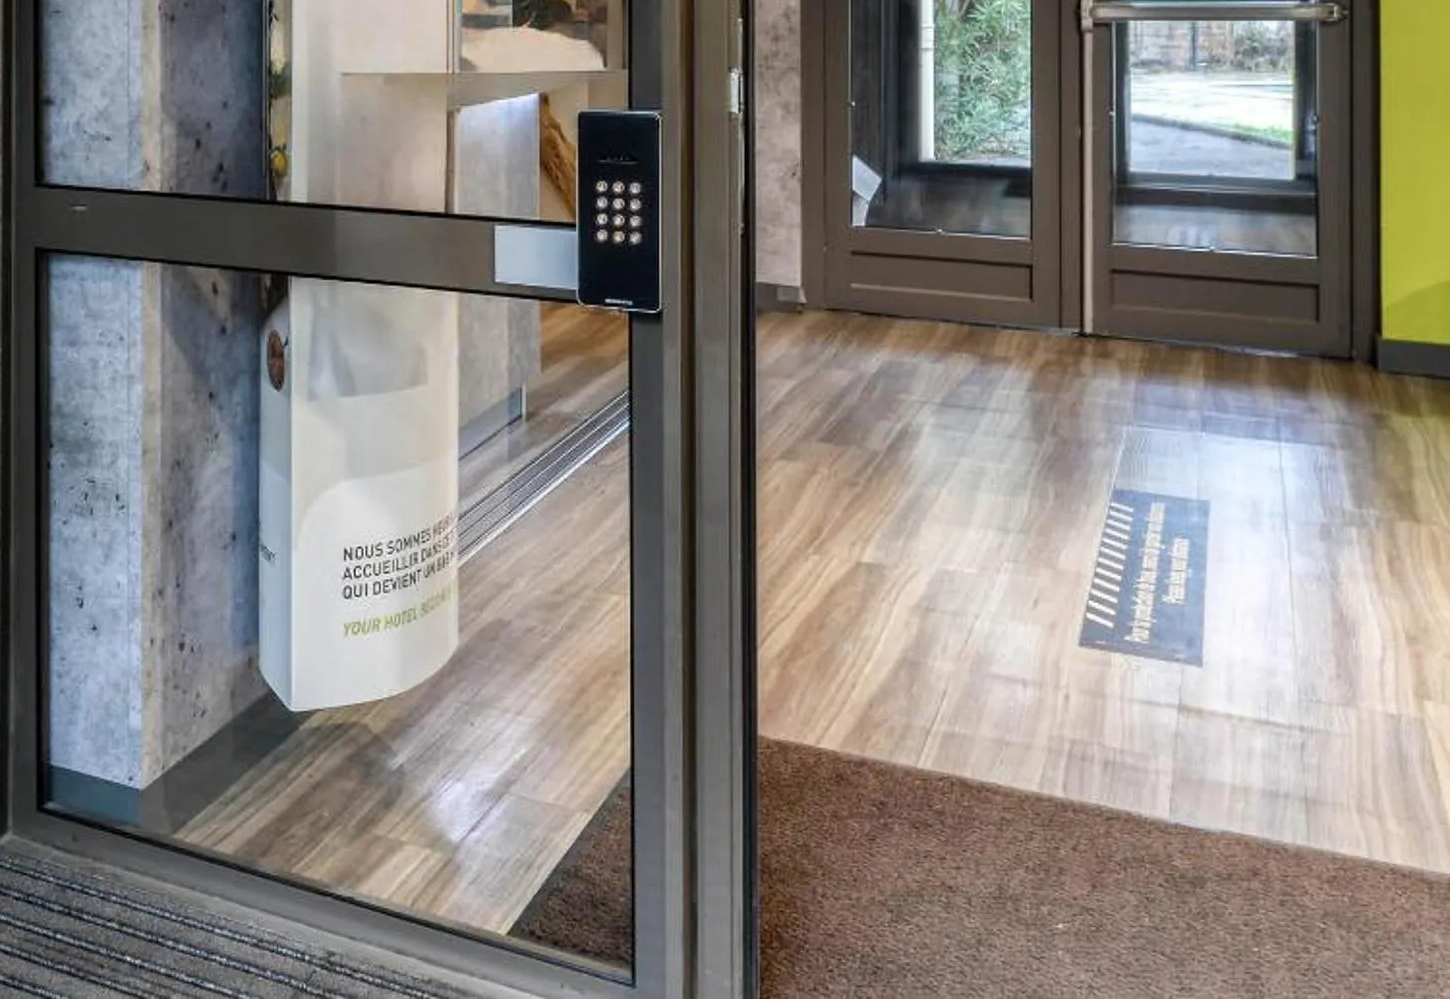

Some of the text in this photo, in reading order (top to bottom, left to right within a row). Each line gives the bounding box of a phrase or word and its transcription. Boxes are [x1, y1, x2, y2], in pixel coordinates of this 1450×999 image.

[343, 542, 383, 561] NOUS
[386, 528, 431, 555] SOMMES
[342, 551, 419, 581] ACCUEILLIR
[342, 583, 368, 600] QUI
[372, 568, 422, 596] DEVIENT
[343, 617, 382, 637] YOUR
